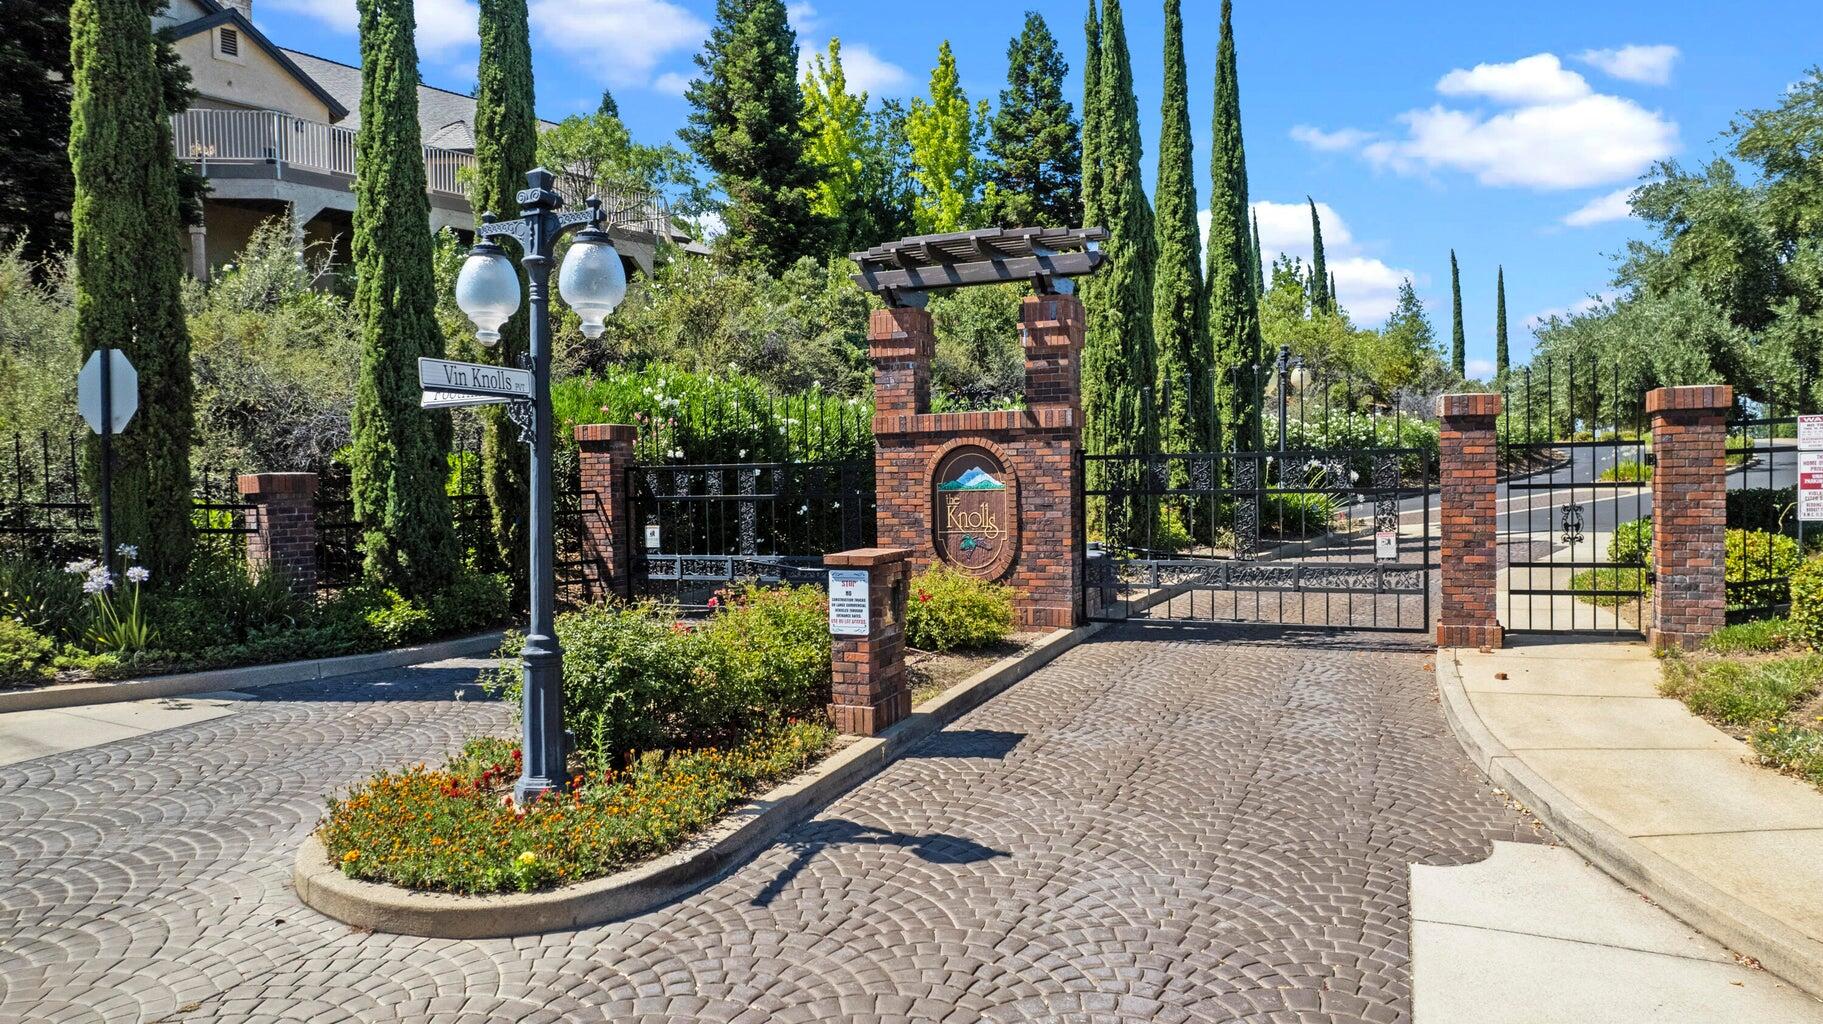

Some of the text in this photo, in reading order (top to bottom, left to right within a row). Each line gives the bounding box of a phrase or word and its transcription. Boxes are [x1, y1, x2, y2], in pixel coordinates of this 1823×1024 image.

[443, 364, 468, 387] Vin
[471, 367, 512, 391] Knolls
[945, 493, 960, 505] the
[946, 502, 999, 539] Knolls
[841, 580, 857, 588] STOP
